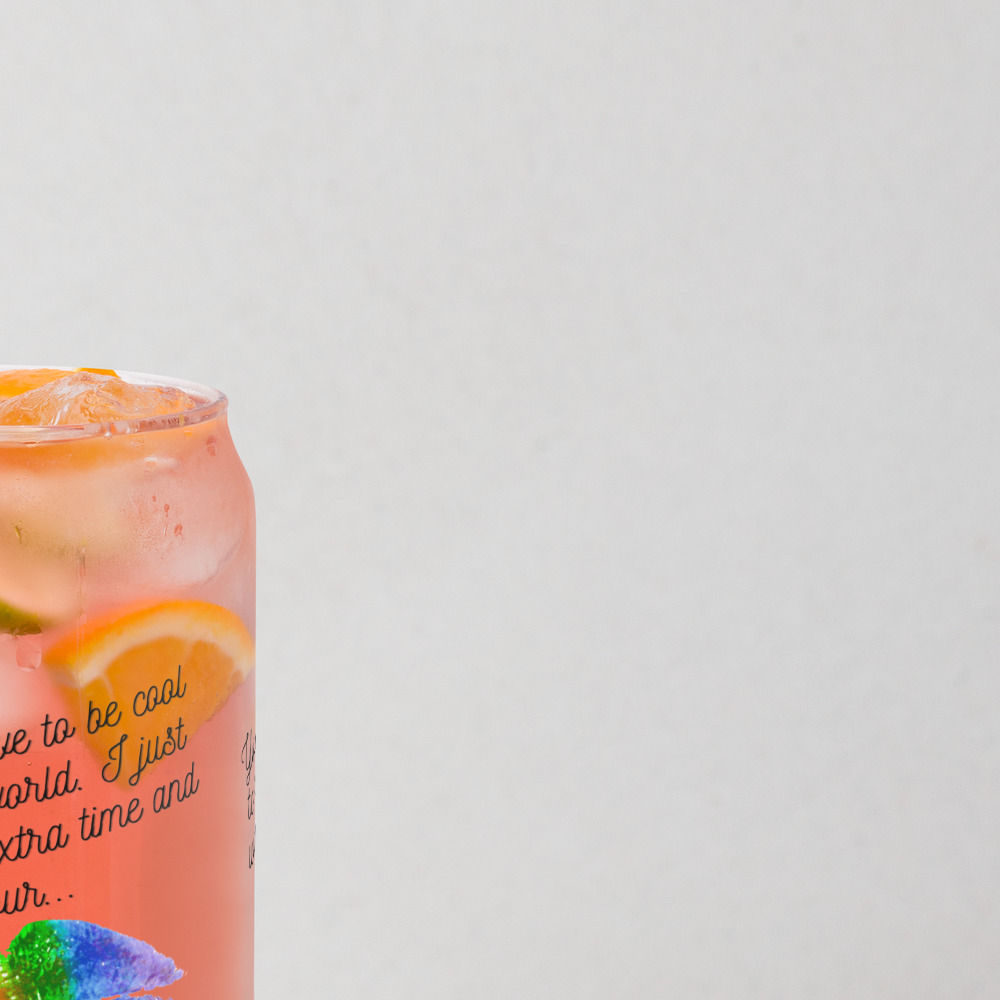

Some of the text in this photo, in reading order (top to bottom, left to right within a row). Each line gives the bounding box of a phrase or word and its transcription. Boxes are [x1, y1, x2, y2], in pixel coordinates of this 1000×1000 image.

[41, 715, 77, 749] to
[87, 701, 122, 735] be
[133, 665, 187, 717] cool
[101, 734, 130, 783] I
[128, 717, 188, 785] just
[78, 792, 144, 842] time
[153, 762, 199, 814] and
